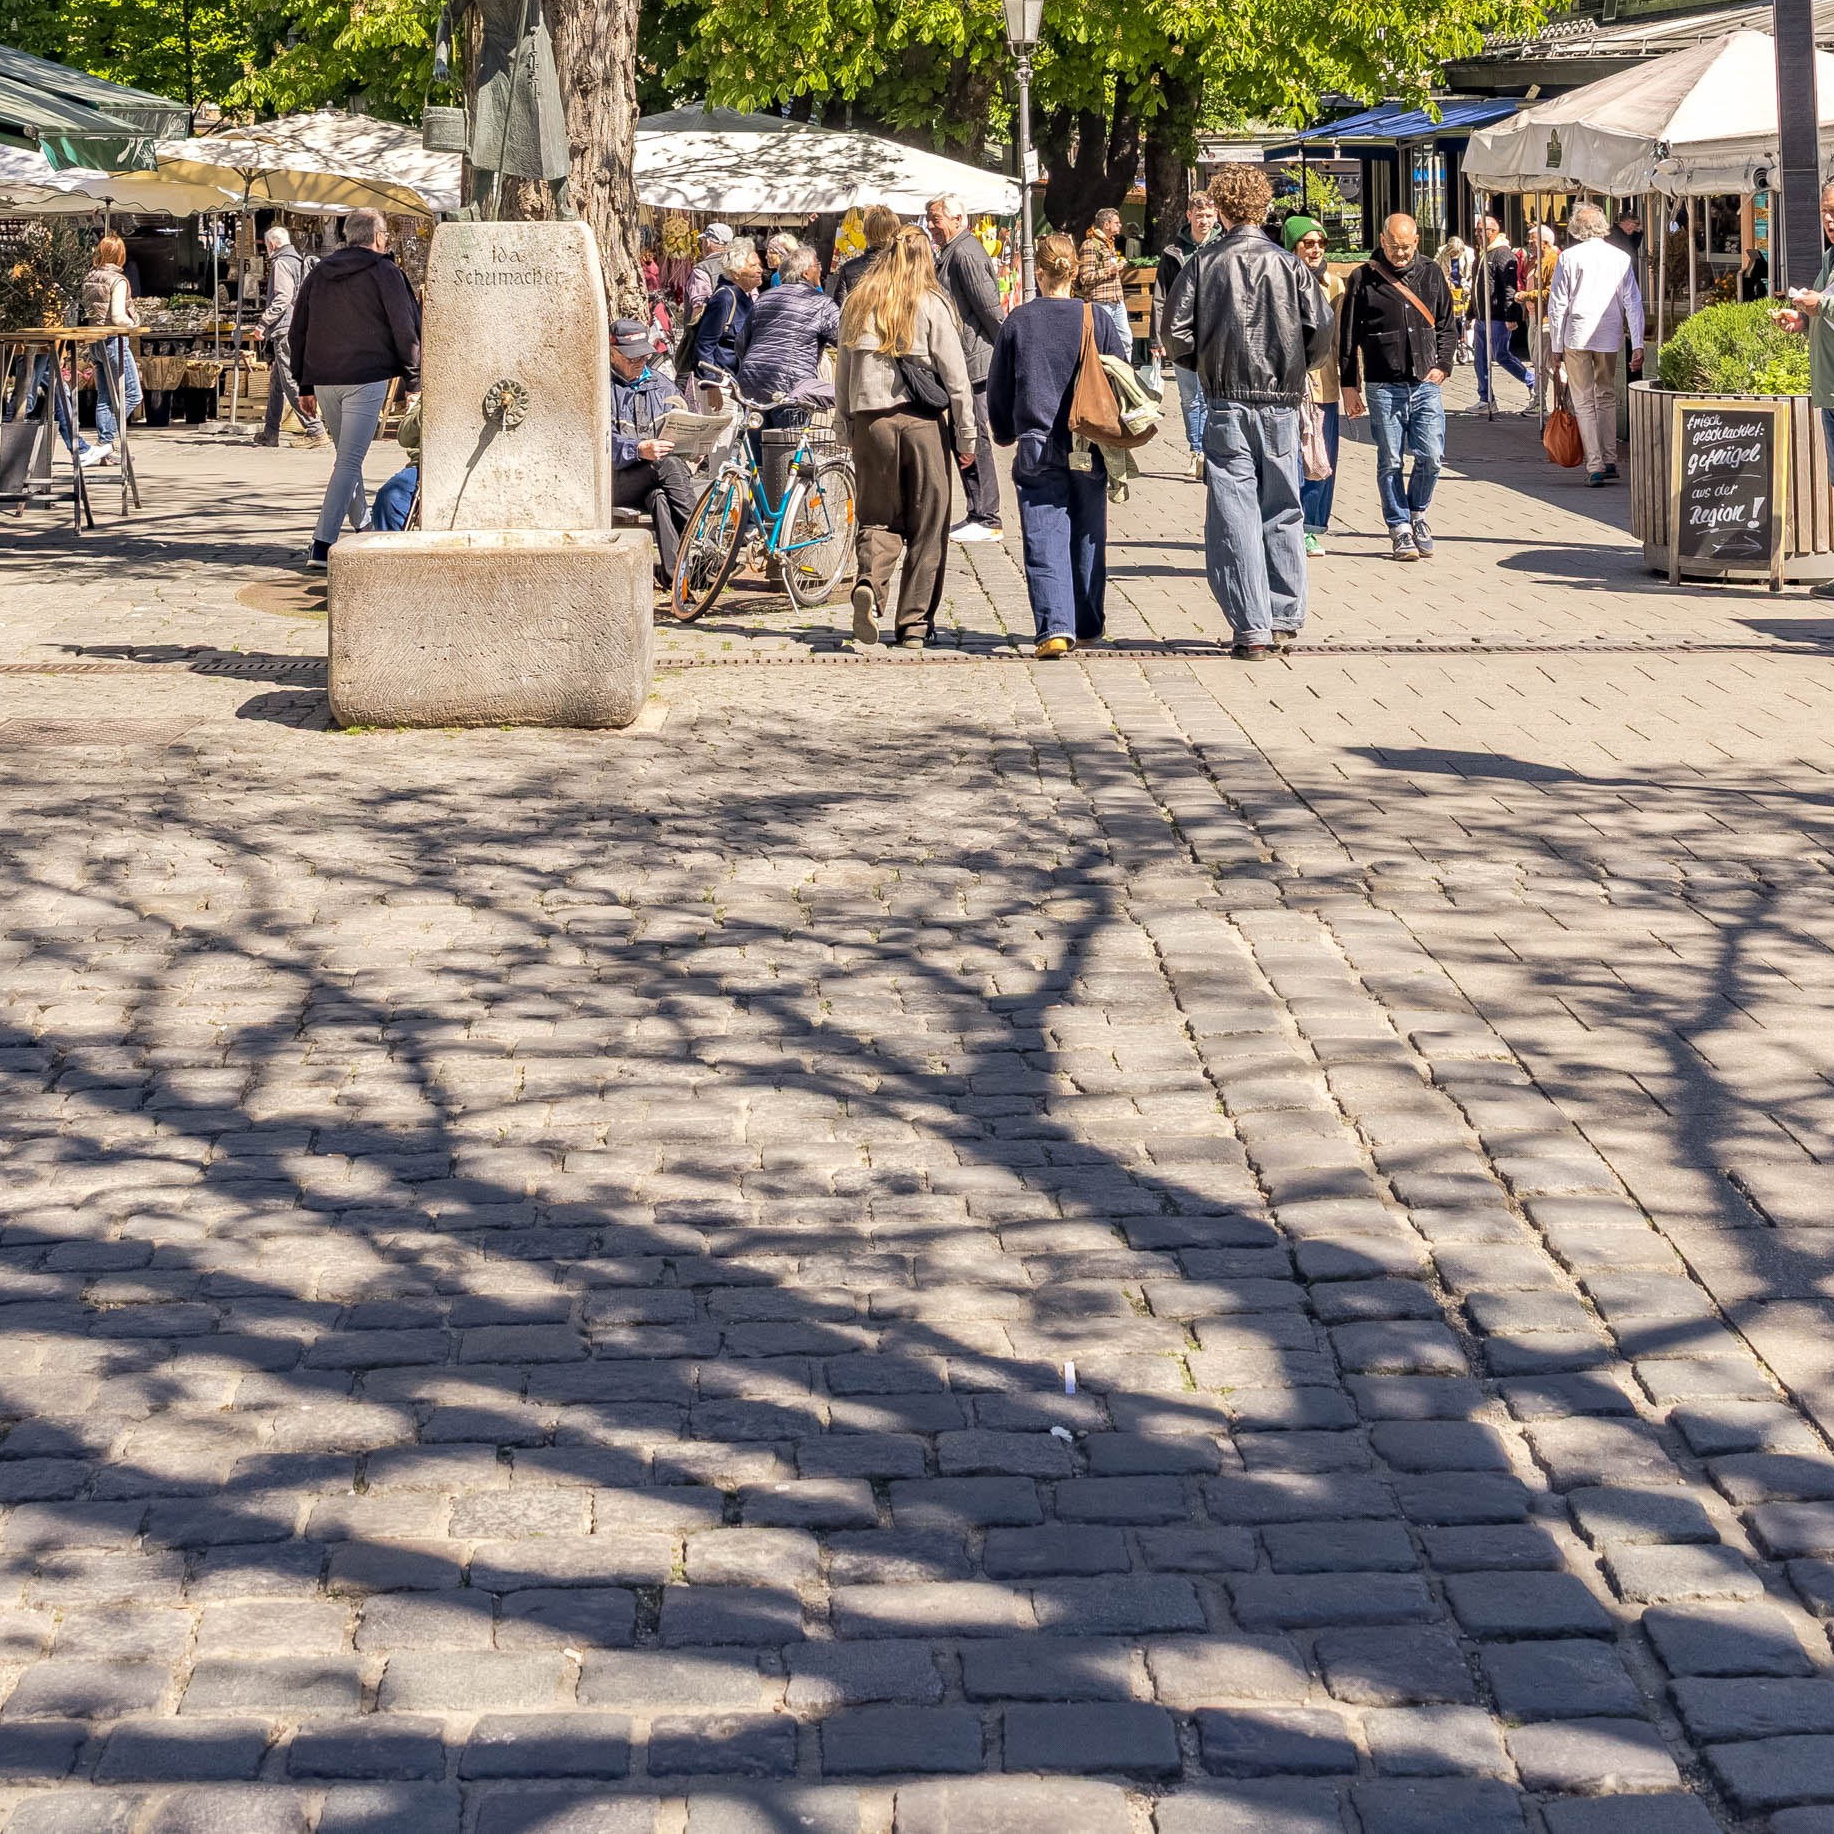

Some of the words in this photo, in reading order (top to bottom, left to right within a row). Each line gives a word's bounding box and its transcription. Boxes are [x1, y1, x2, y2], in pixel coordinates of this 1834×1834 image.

[453, 268, 565, 286] Schumacher
[1686, 414, 1723, 430] frisch
[1692, 487, 1711, 499] aus
[1714, 483, 1739, 497] der
